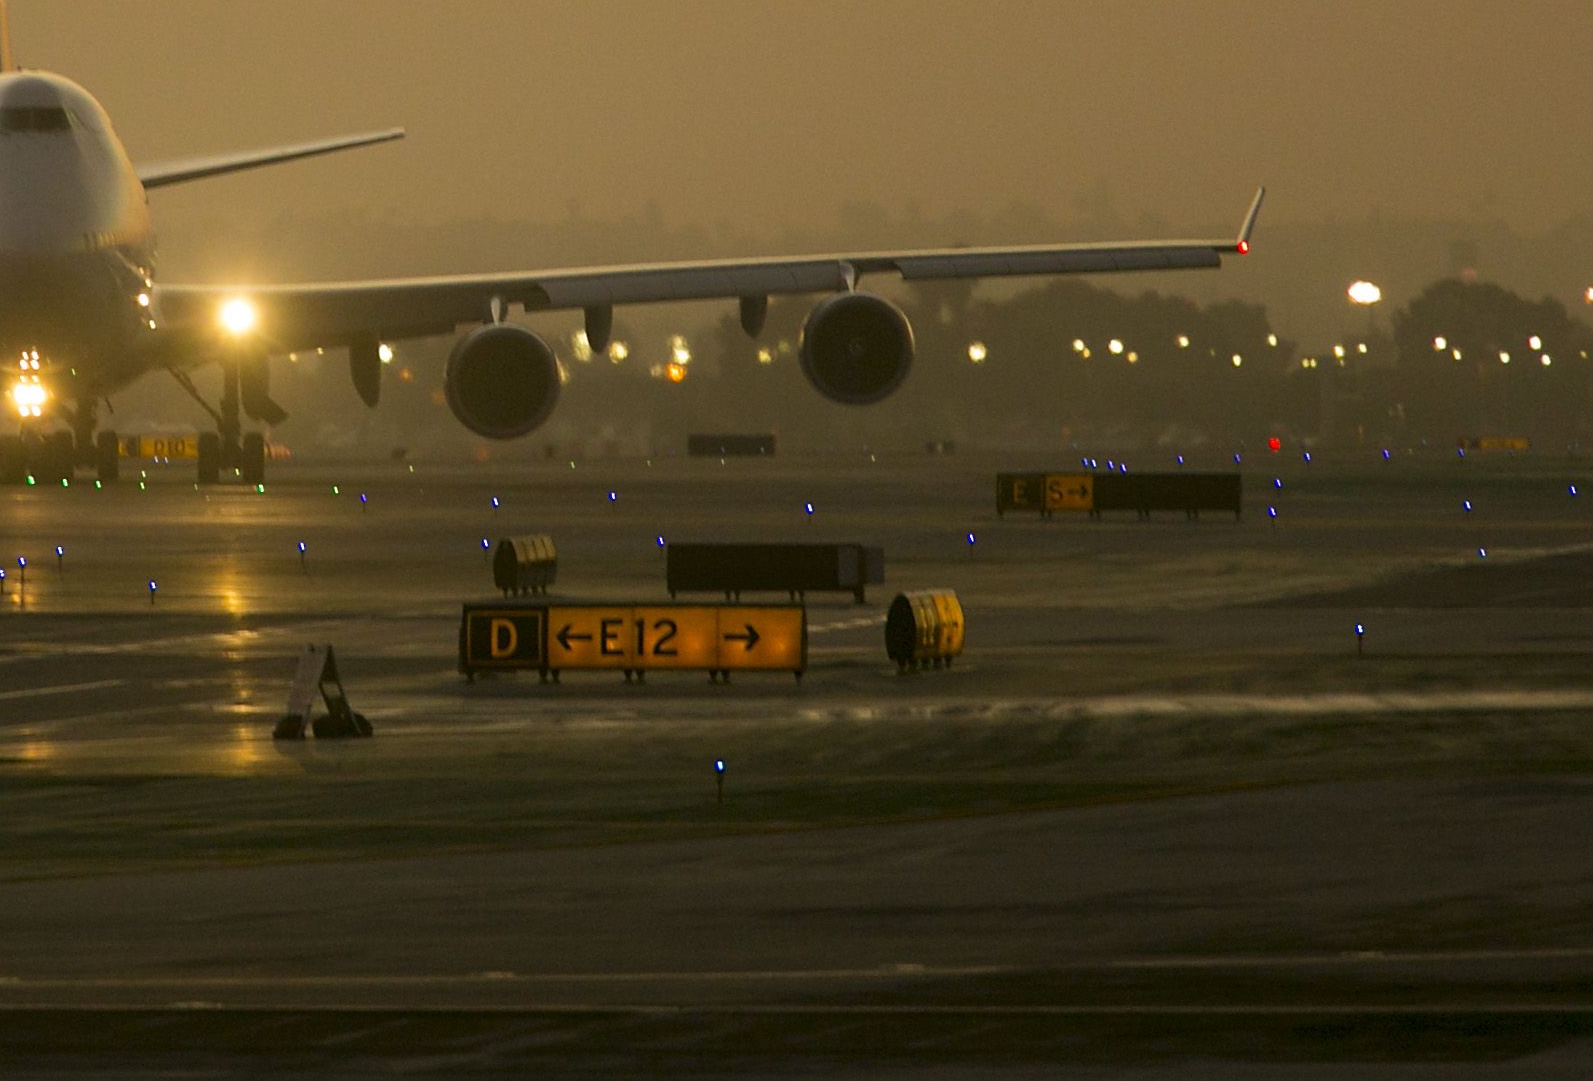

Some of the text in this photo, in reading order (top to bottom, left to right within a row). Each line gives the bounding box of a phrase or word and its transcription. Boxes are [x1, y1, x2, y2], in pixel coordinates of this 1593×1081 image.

[1013, 479, 1063, 502] E S
[489, 617, 678, 659] D E12
